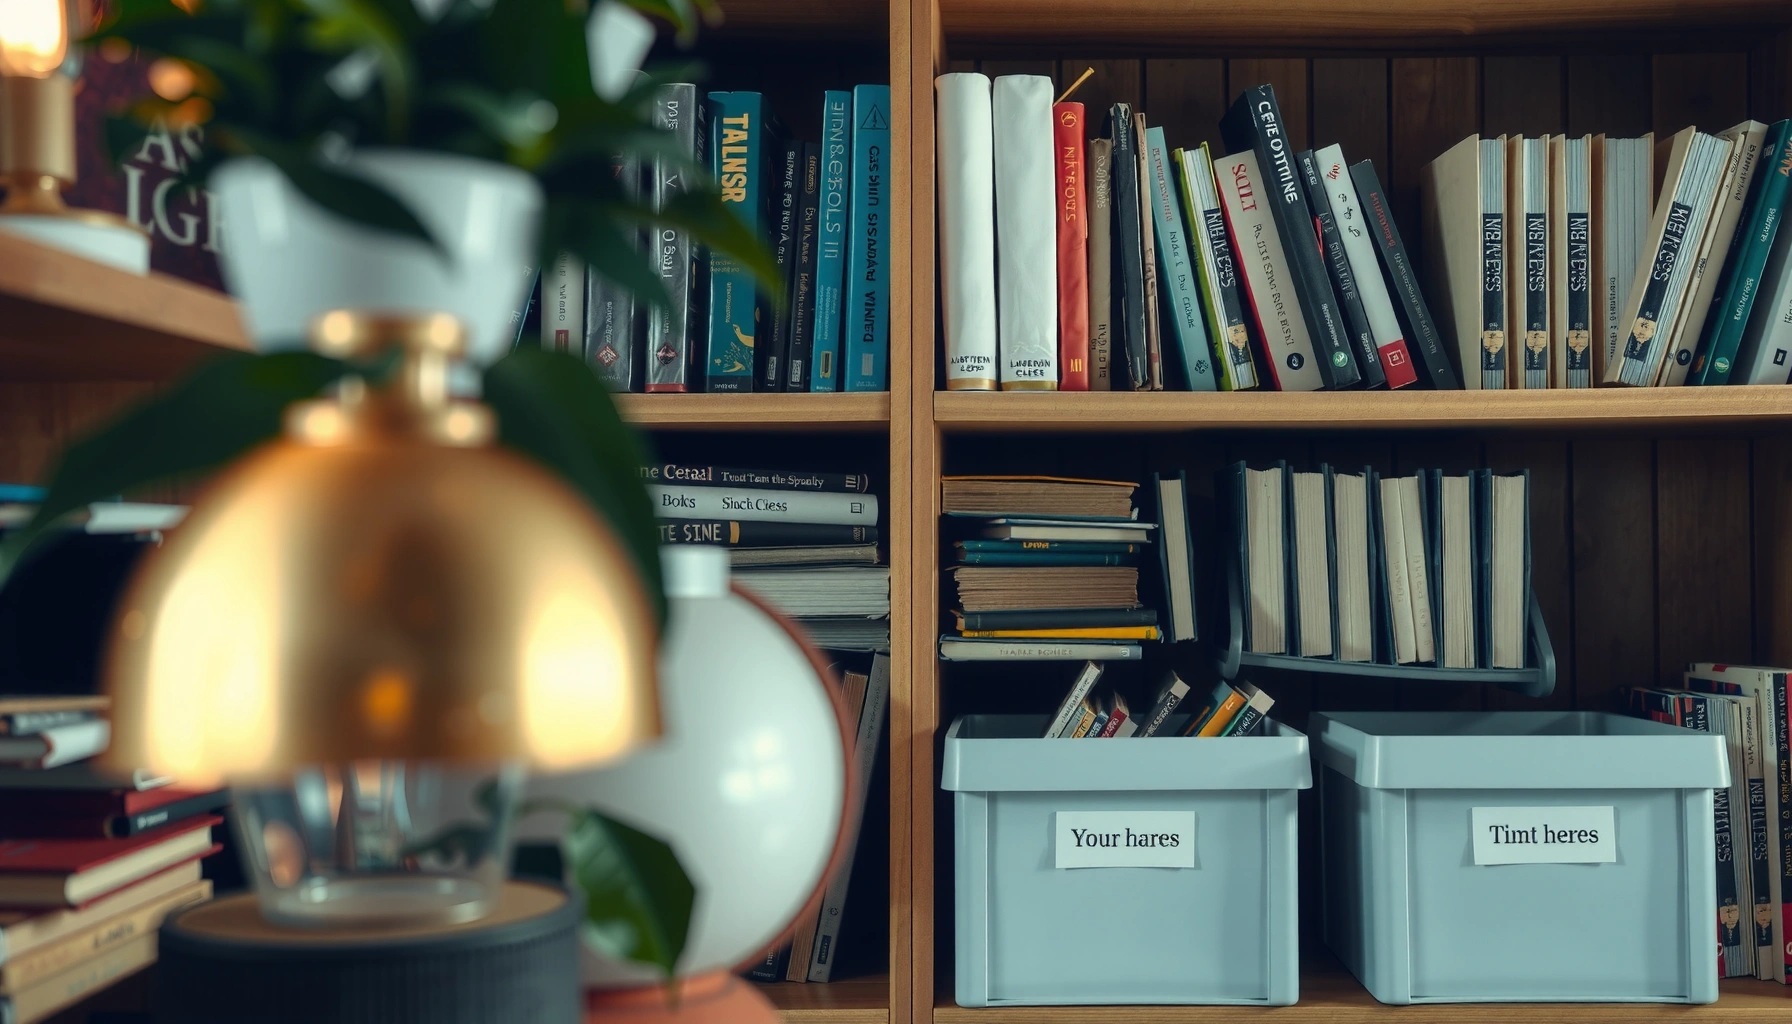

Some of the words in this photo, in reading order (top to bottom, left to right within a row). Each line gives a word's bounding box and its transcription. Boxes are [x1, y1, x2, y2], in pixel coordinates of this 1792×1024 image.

[682, 522, 723, 543] SINE
[1070, 828, 1121, 848] Your
[1124, 827, 1180, 848] hares
[1488, 824, 1539, 844] Timt
[1543, 824, 1600, 844] heres
